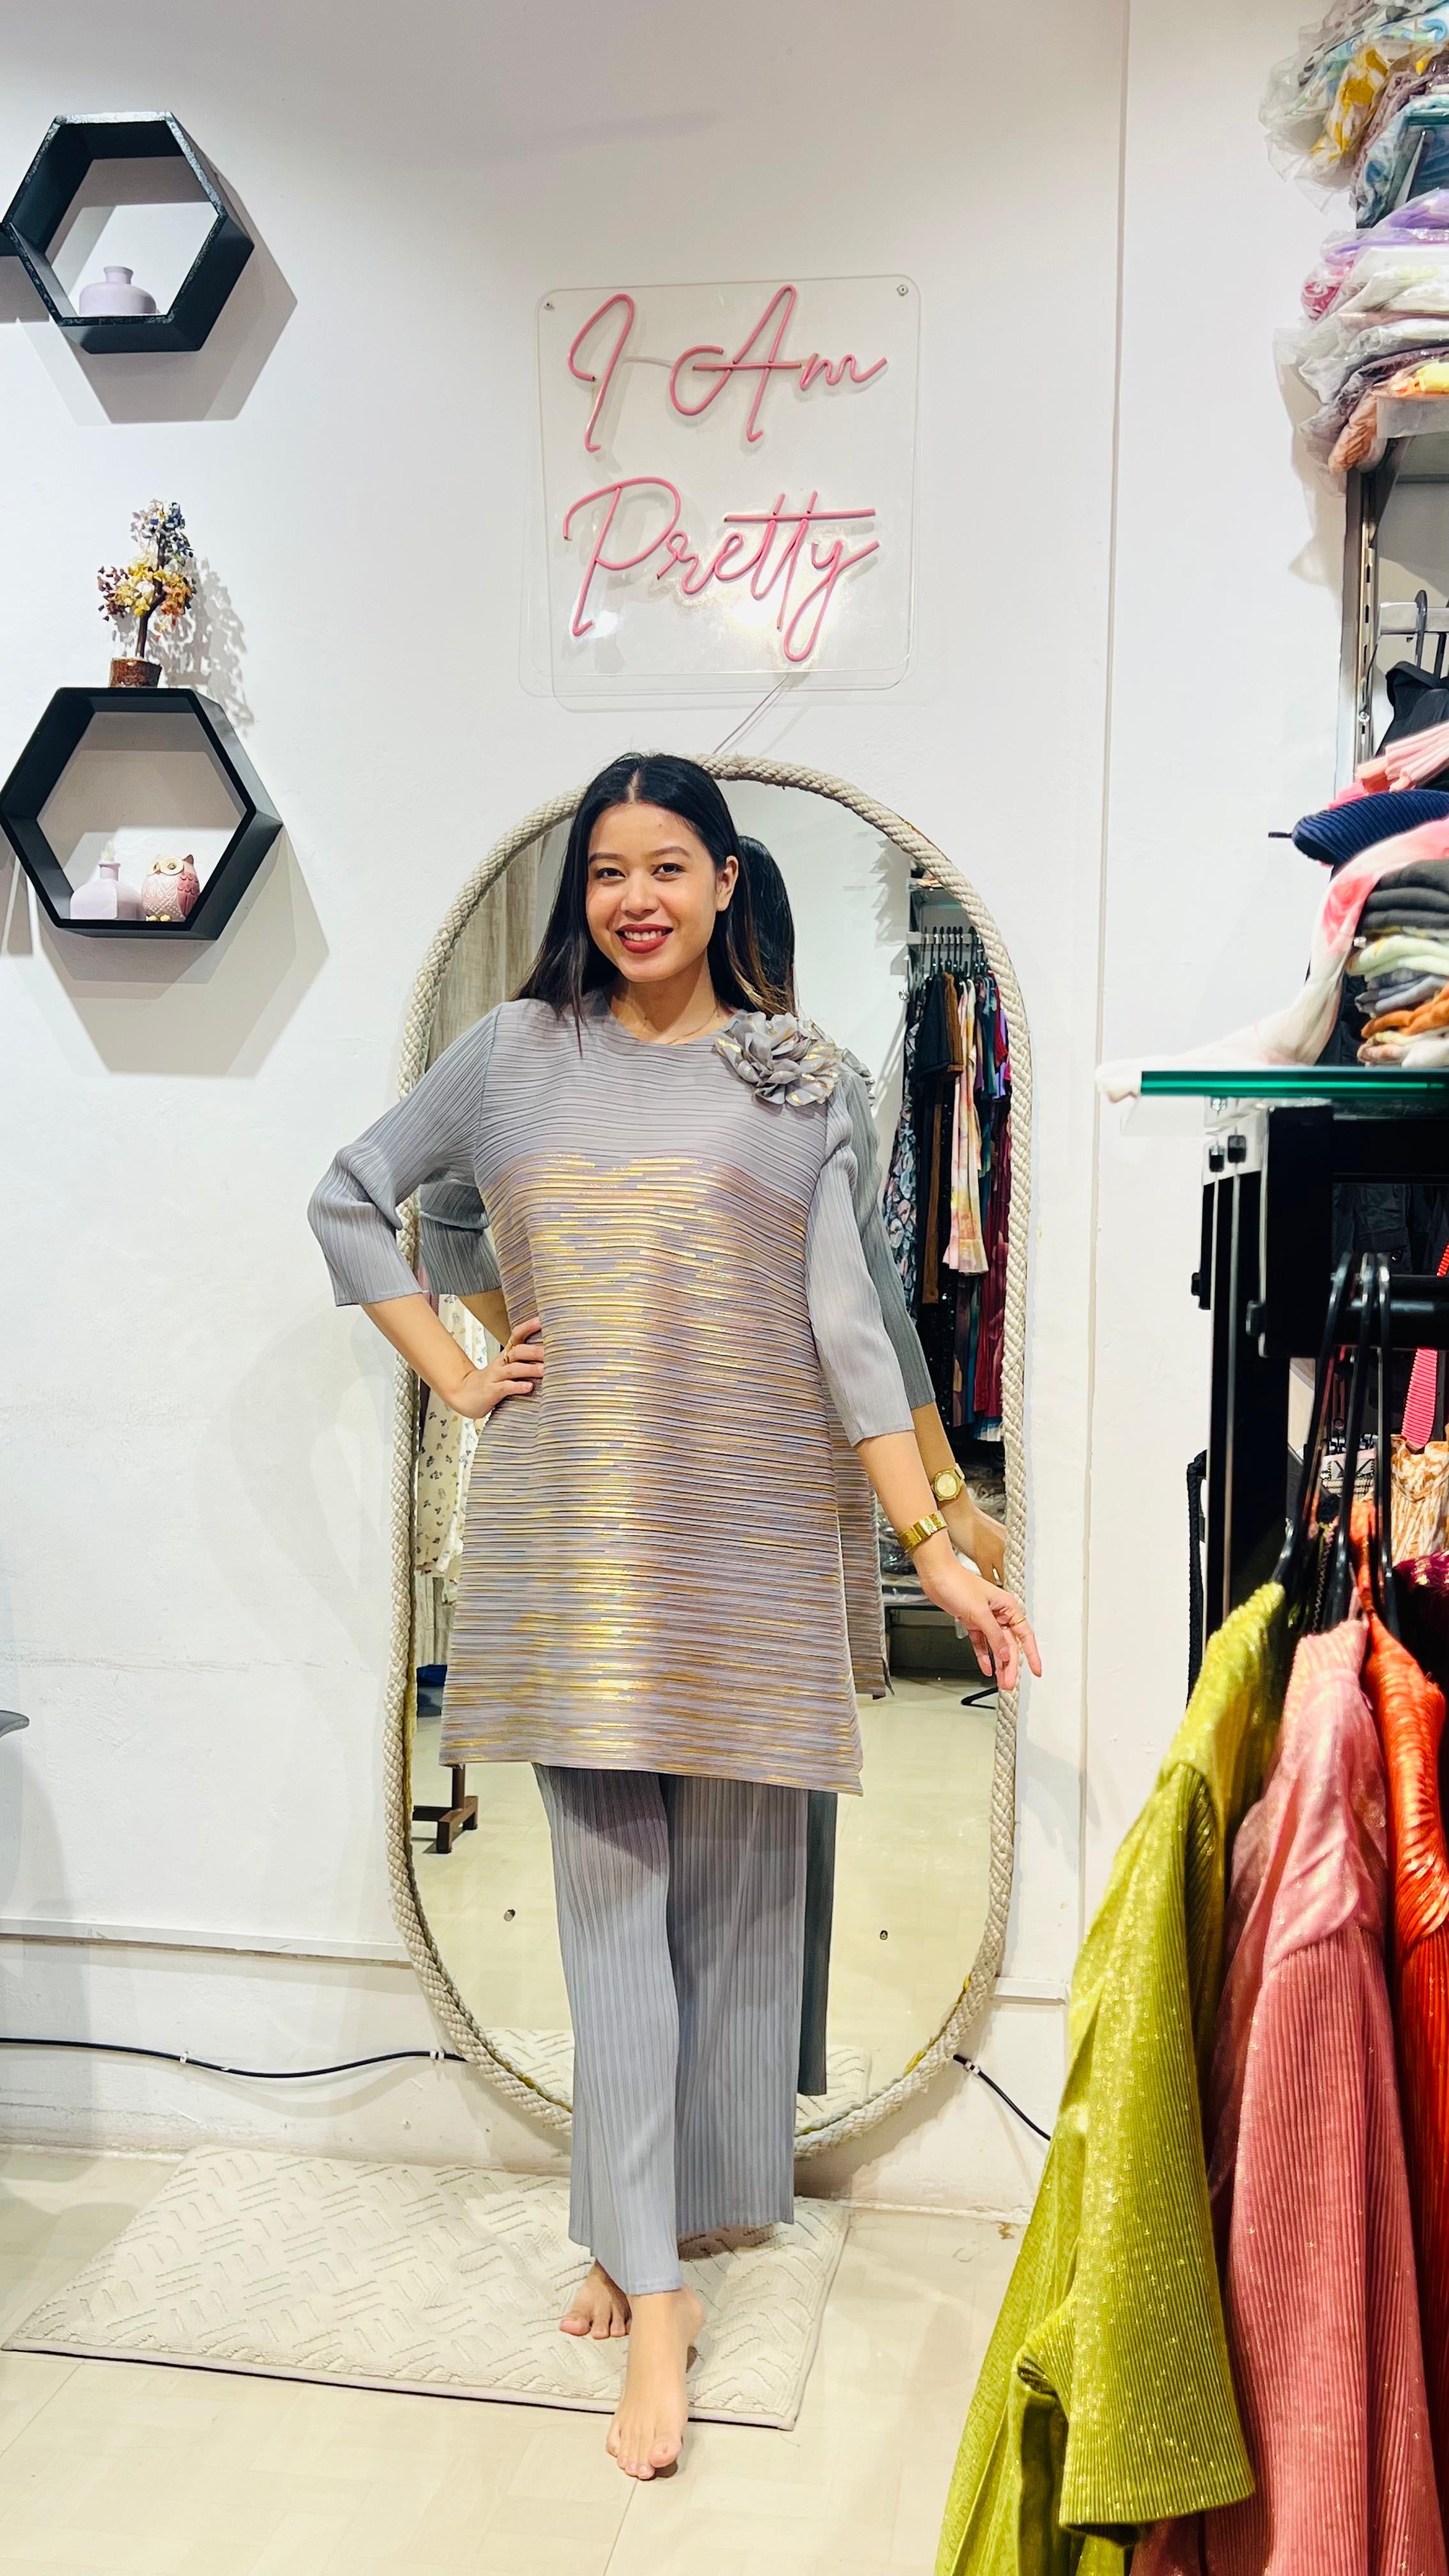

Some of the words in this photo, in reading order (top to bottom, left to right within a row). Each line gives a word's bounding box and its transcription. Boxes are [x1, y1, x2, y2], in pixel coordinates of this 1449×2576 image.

[568, 294, 634, 451] I
[670, 285, 887, 441] Am
[564, 477, 879, 661] Pretty
